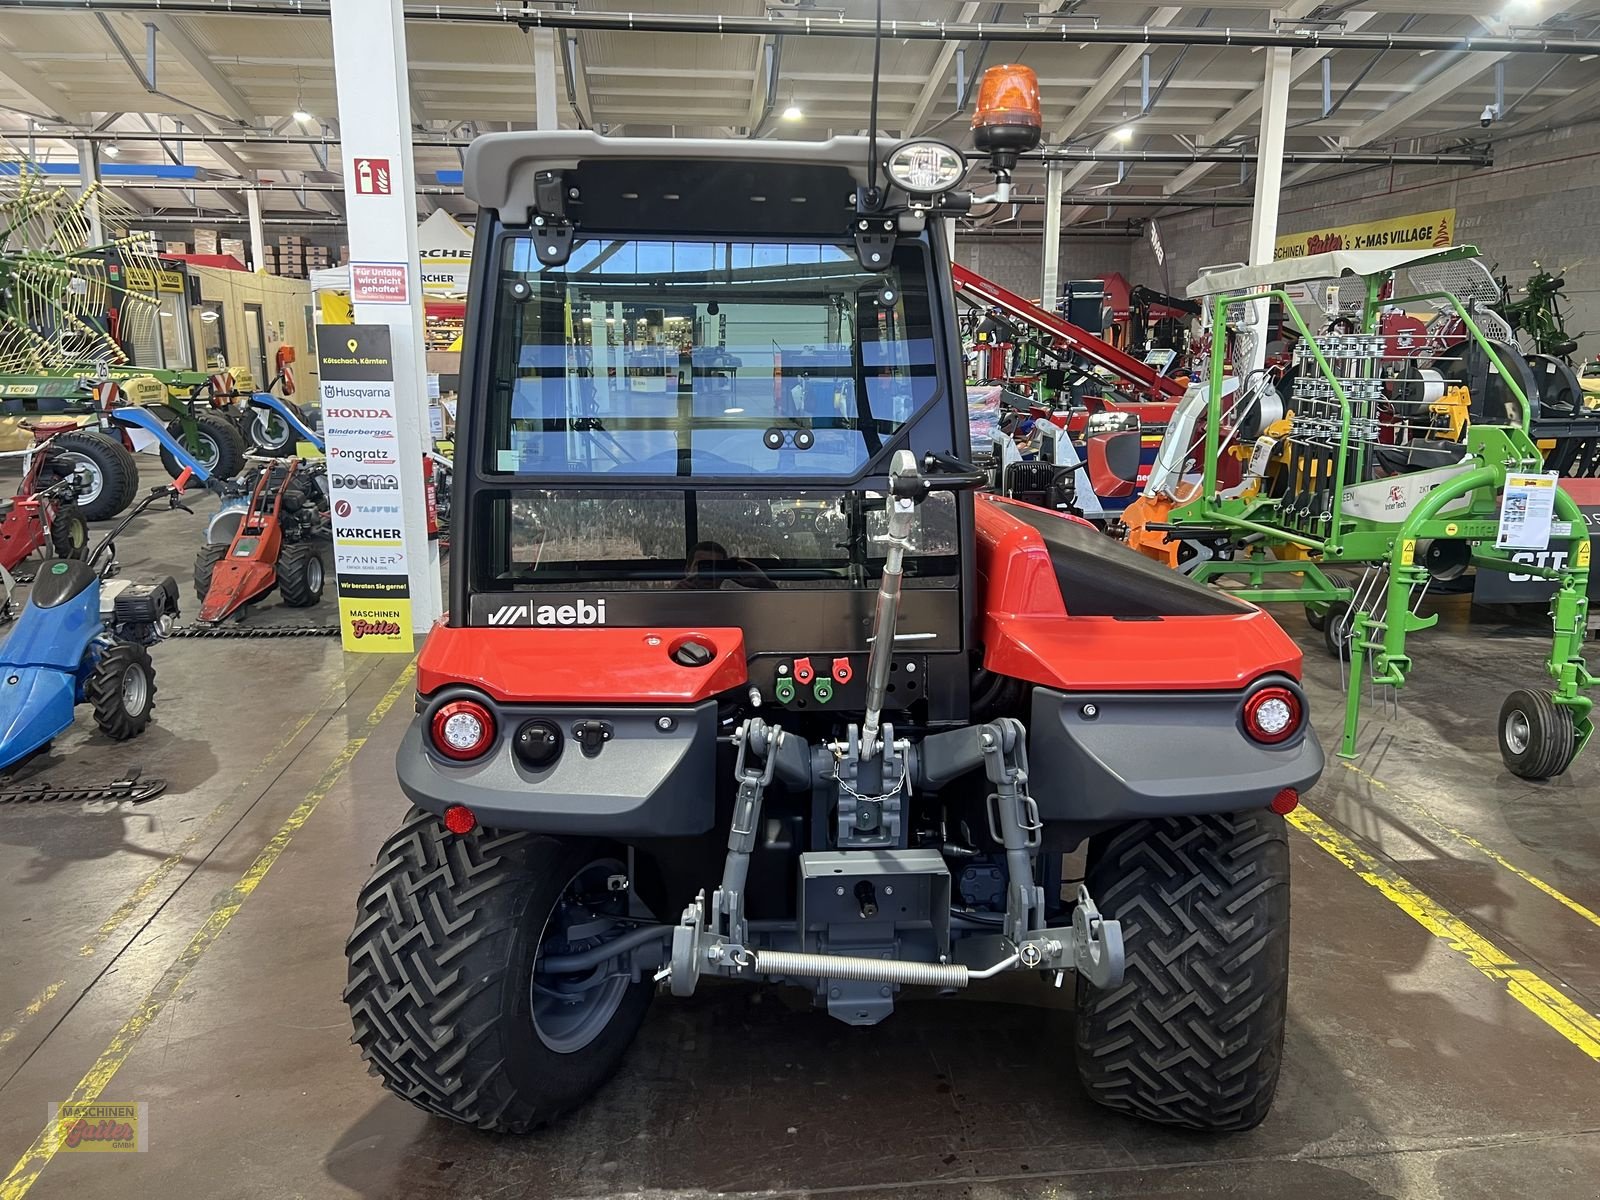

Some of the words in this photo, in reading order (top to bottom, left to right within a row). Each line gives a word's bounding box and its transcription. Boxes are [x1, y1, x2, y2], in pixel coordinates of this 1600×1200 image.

[1354, 233, 1389, 249] X-MAS
[1390, 226, 1433, 243] VILLAGE
[354, 267, 370, 276] Für
[371, 268, 402, 276] Unfälle
[358, 276, 378, 284] wird
[378, 277, 402, 285] nicht
[361, 285, 399, 294] gehaftet
[322, 357, 360, 365] Kötschach,
[360, 357, 388, 365] Kärnten
[335, 387, 391, 398] Husqvarna
[326, 408, 393, 418] HONDA
[328, 428, 392, 436] Binderberger
[330, 447, 388, 462] Pongratz
[332, 474, 399, 490] DOCMA
[1418, 485, 1430, 494] ZKT
[356, 505, 399, 513] TAJFUN
[336, 528, 402, 539] KÄRCHER
[338, 555, 396, 564] PFANNER
[350, 610, 400, 618] MASCHINEN
[537, 598, 606, 625] aebi
